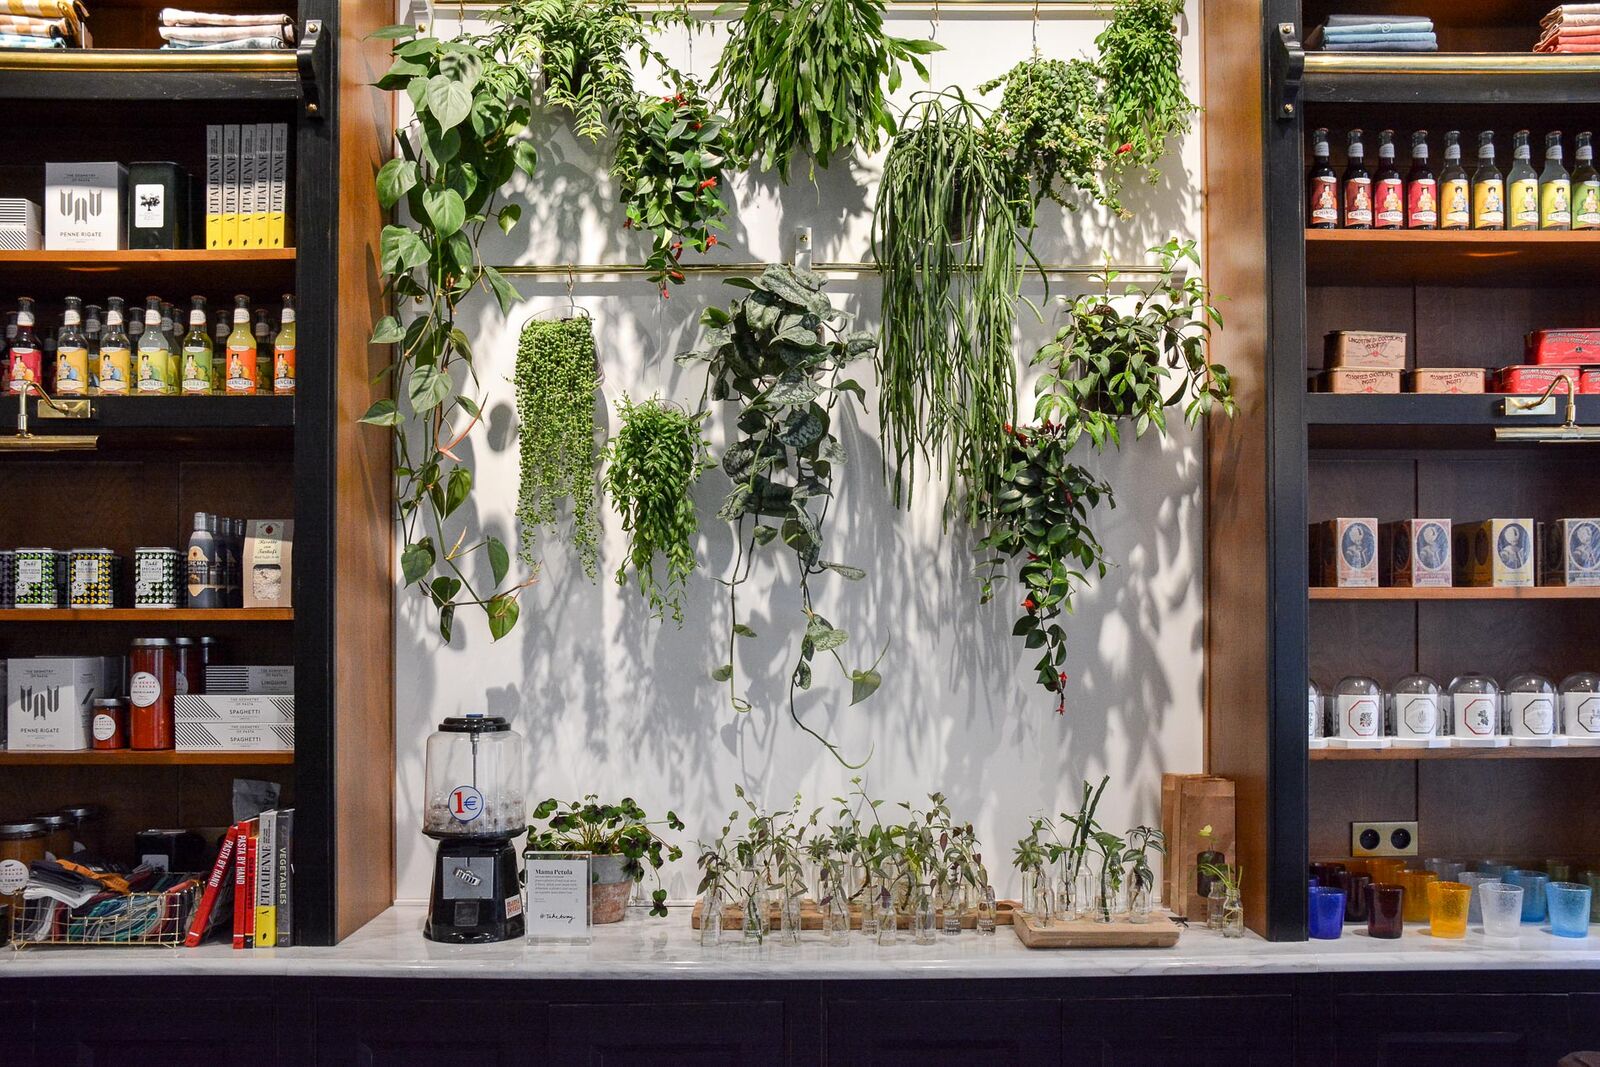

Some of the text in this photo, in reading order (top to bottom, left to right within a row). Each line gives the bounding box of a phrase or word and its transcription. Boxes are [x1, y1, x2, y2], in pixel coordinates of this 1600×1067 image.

[454, 791, 478, 814] 1€
[210, 839, 234, 888] PASTA BY HAND
[236, 834, 246, 885] PASTA BY HAND
